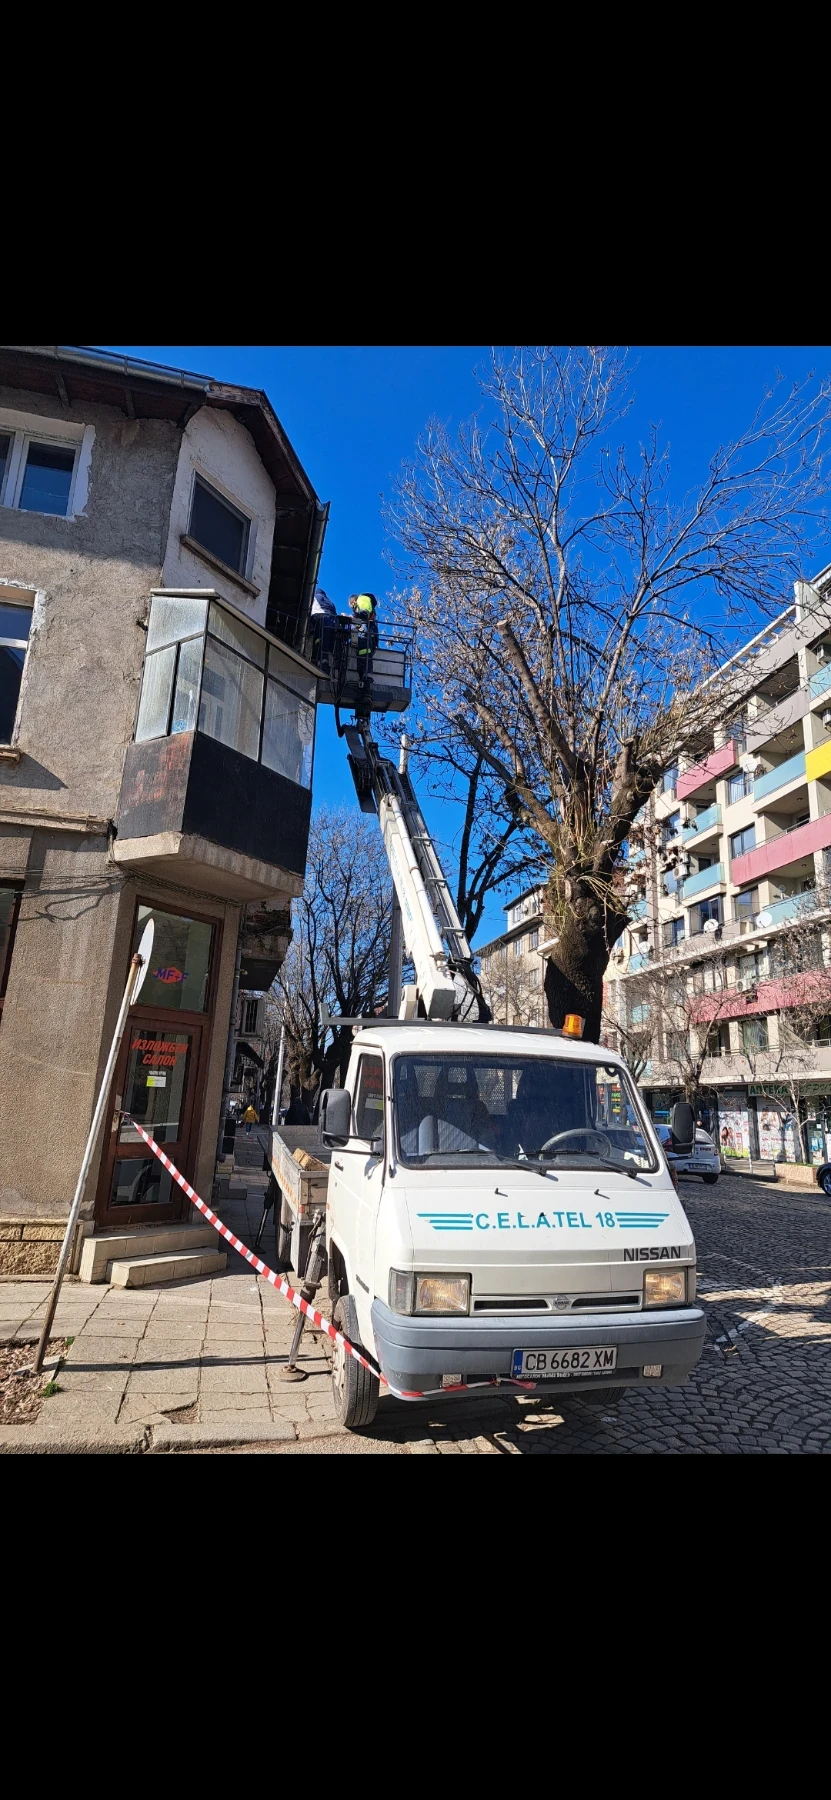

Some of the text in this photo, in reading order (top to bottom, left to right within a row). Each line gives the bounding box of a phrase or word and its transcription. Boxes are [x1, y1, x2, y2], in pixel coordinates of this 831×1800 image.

[142, 1054, 177, 1067] САЛОН
[750, 1085, 788, 1095] АПТЕКА
[475, 1212, 615, 1229] C.E.L.A.TEL 18
[623, 1246, 680, 1261] NISSAN
[525, 1349, 614, 1371] CB 6682 XM
